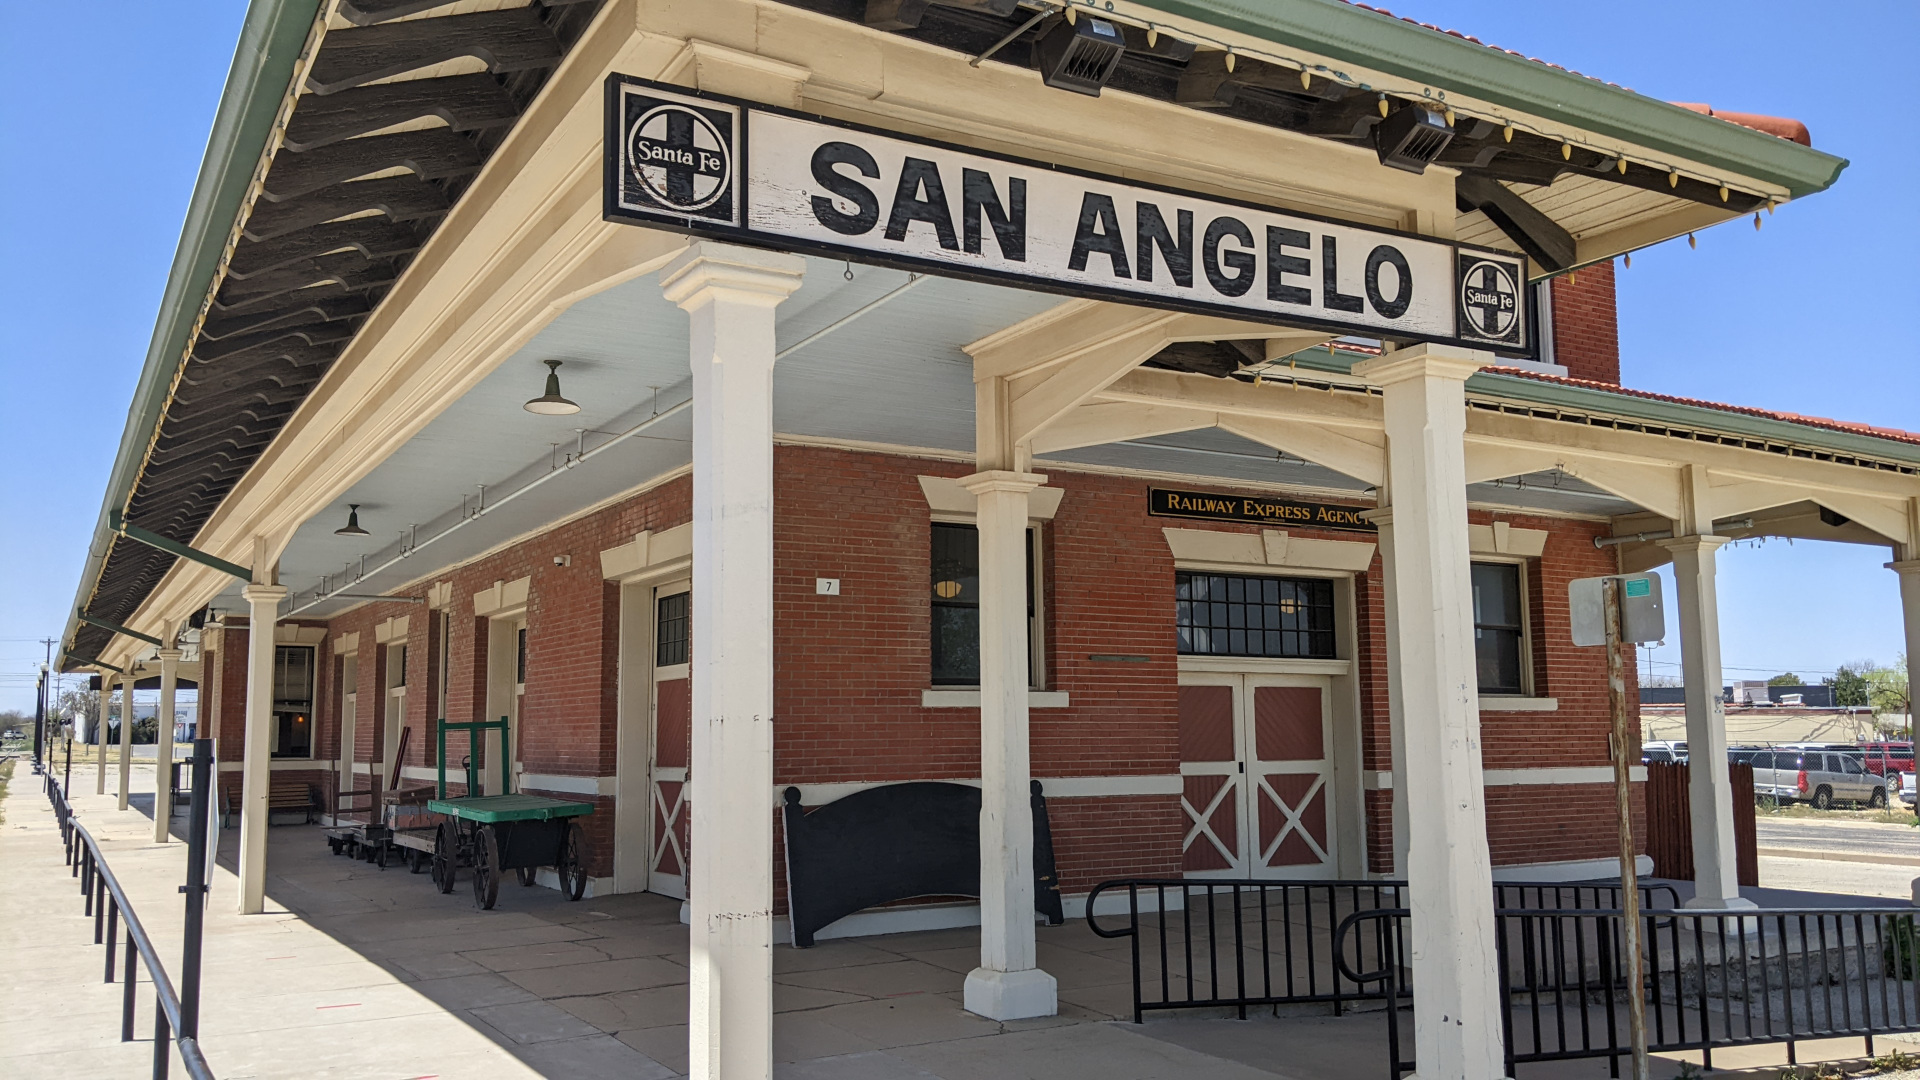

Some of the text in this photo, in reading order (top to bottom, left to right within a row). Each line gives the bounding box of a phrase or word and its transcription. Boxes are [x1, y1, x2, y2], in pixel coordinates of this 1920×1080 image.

[638, 141, 721, 172] Santa Fe
[810, 141, 1413, 319] SAN ANGELO
[1467, 289, 1513, 310] Santa Fe
[1167, 493, 1237, 514] RAILWAY
[1243, 500, 1311, 520] EXPRESS
[826, 581, 832, 592] 7
